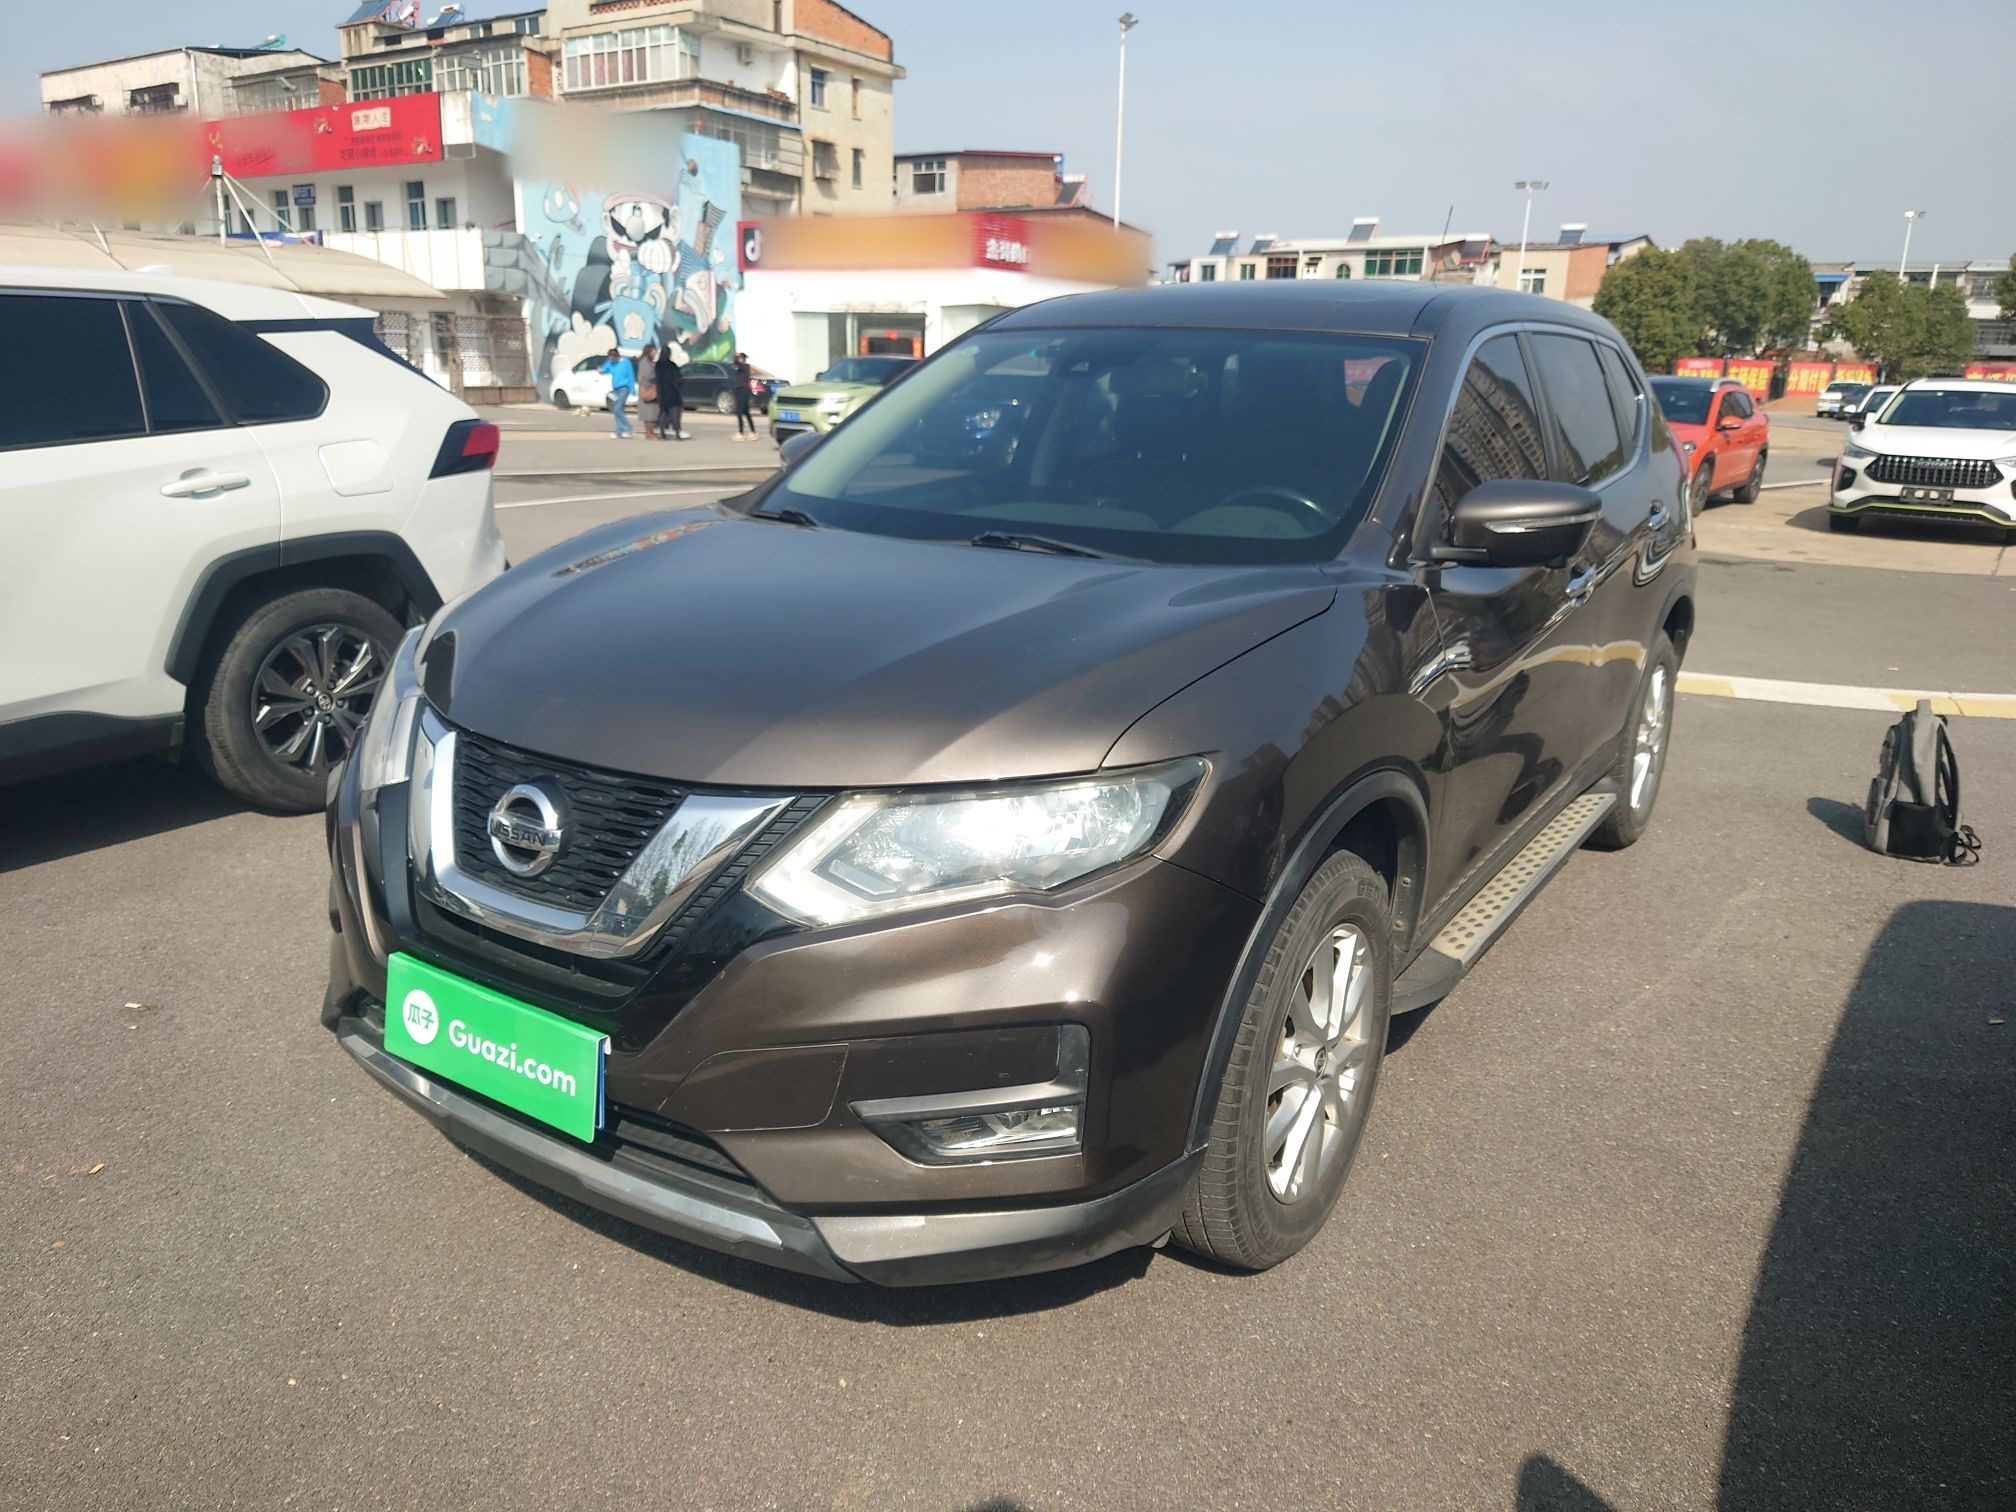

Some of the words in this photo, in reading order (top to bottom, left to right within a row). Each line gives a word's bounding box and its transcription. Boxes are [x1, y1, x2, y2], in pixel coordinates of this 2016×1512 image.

[490, 818, 546, 846] NISSAN
[407, 1003, 434, 1030] 瓜子
[448, 1019, 576, 1097] Guazi.com
